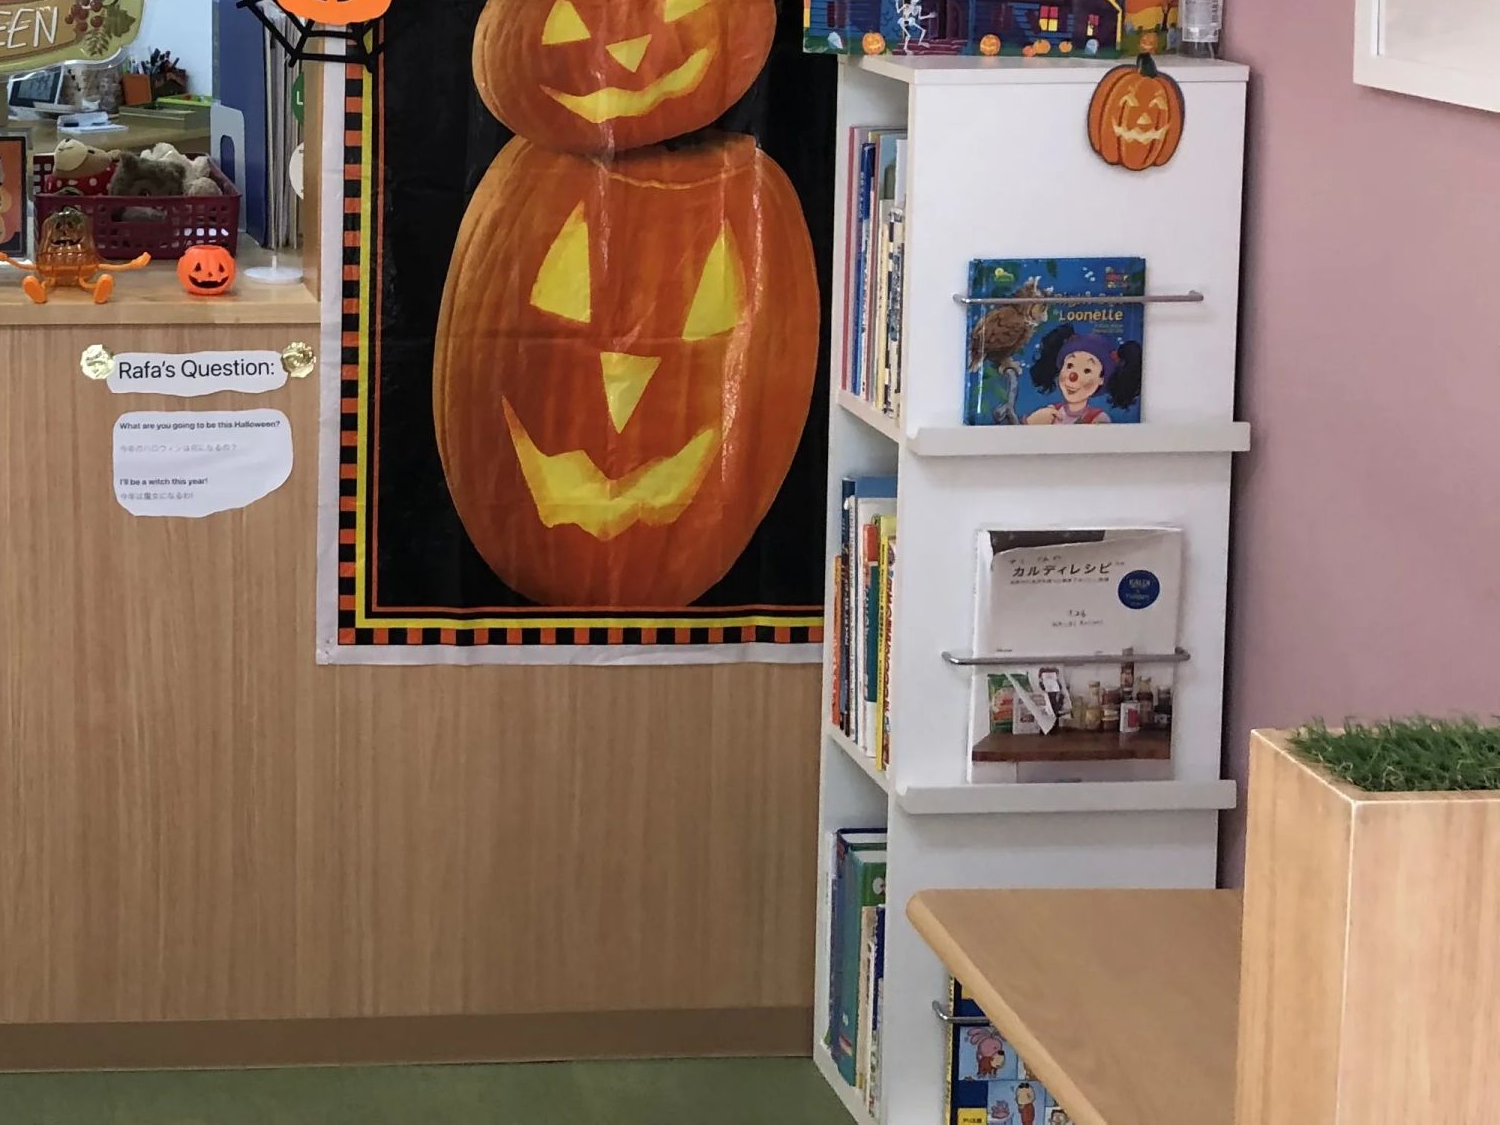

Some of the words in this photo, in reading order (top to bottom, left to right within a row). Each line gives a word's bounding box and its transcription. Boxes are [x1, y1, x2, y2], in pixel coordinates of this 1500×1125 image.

[119, 360, 176, 379] Rafa's
[181, 359, 275, 378] Question:
[173, 422, 195, 430] going
[234, 420, 281, 428] Halloween?
[188, 478, 208, 486] year!
[1013, 563, 1112, 577] カルディレシピ
